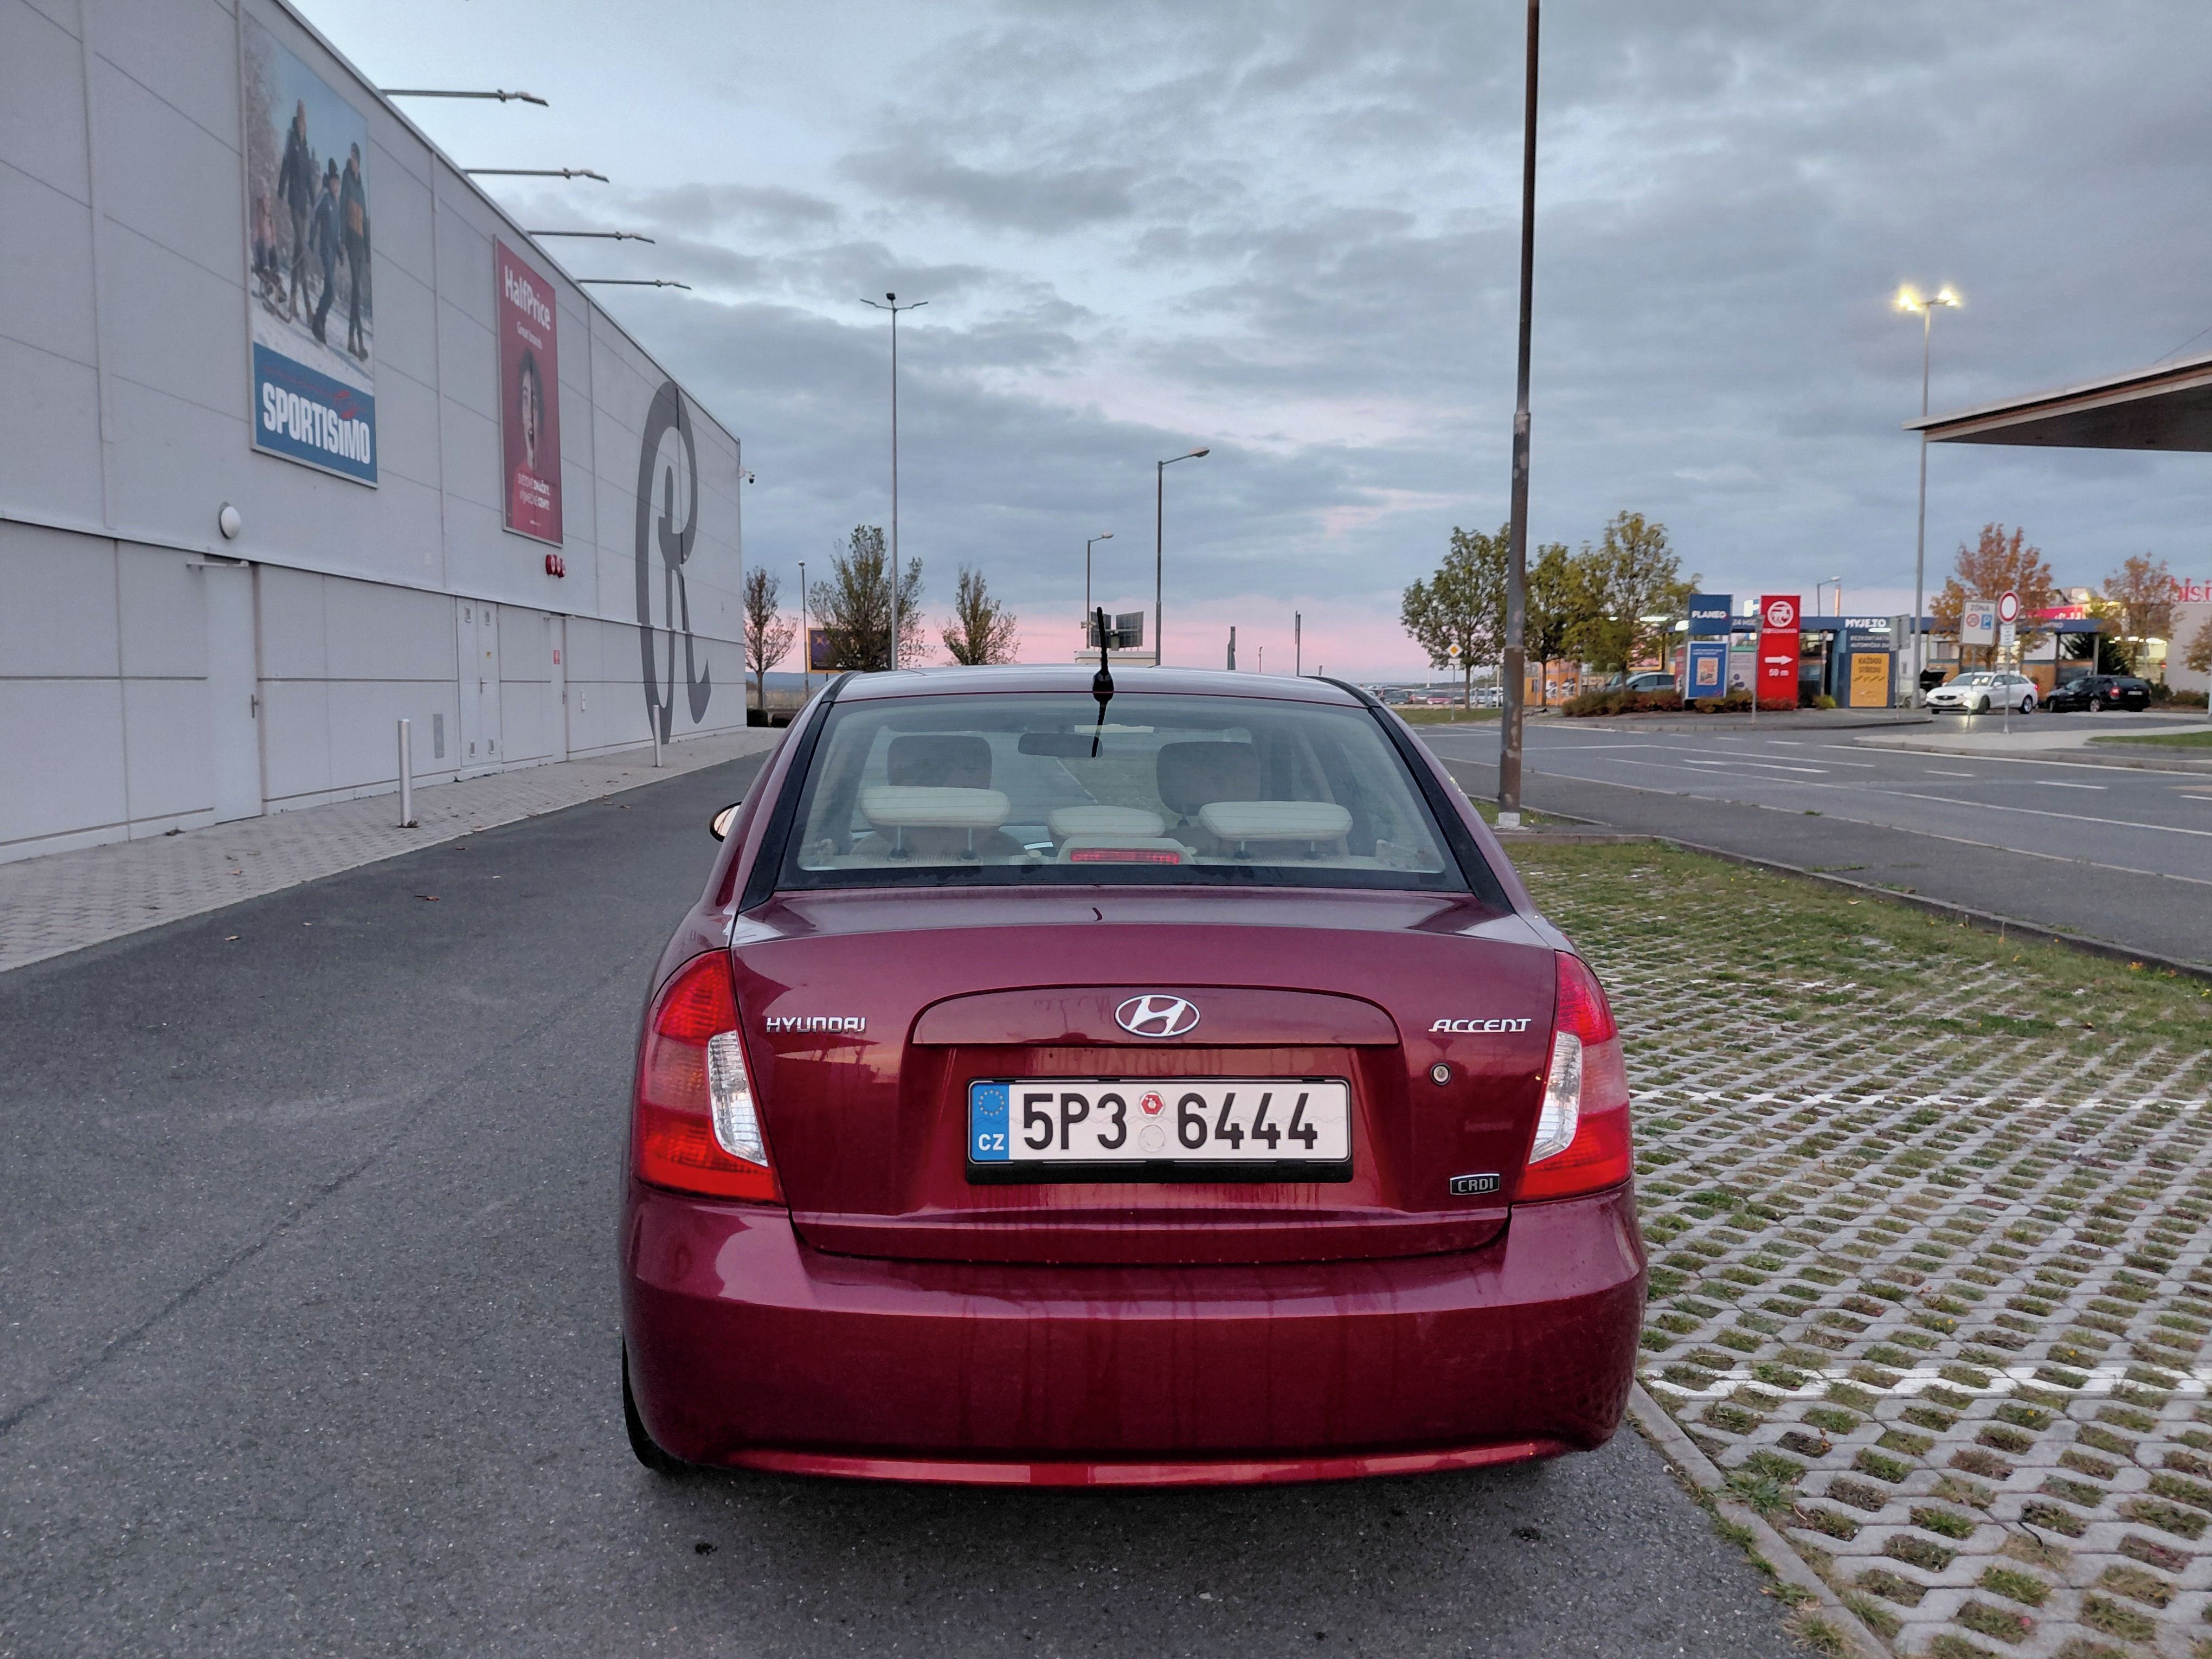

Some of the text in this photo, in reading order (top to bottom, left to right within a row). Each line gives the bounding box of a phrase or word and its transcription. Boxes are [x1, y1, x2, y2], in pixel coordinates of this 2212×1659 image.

[504, 265, 550, 331] HalfPrice
[262, 382, 371, 465] SPORTISIMO
[1691, 610, 1726, 619] PLANEO
[766, 1015, 866, 1034] HYUNDAI
[1428, 1018, 1532, 1033] ACCENT
[1023, 1092, 1318, 1150] 5P3 6444
[978, 1133, 1005, 1152] CZ
[1457, 1177, 1494, 1192] CRDI
